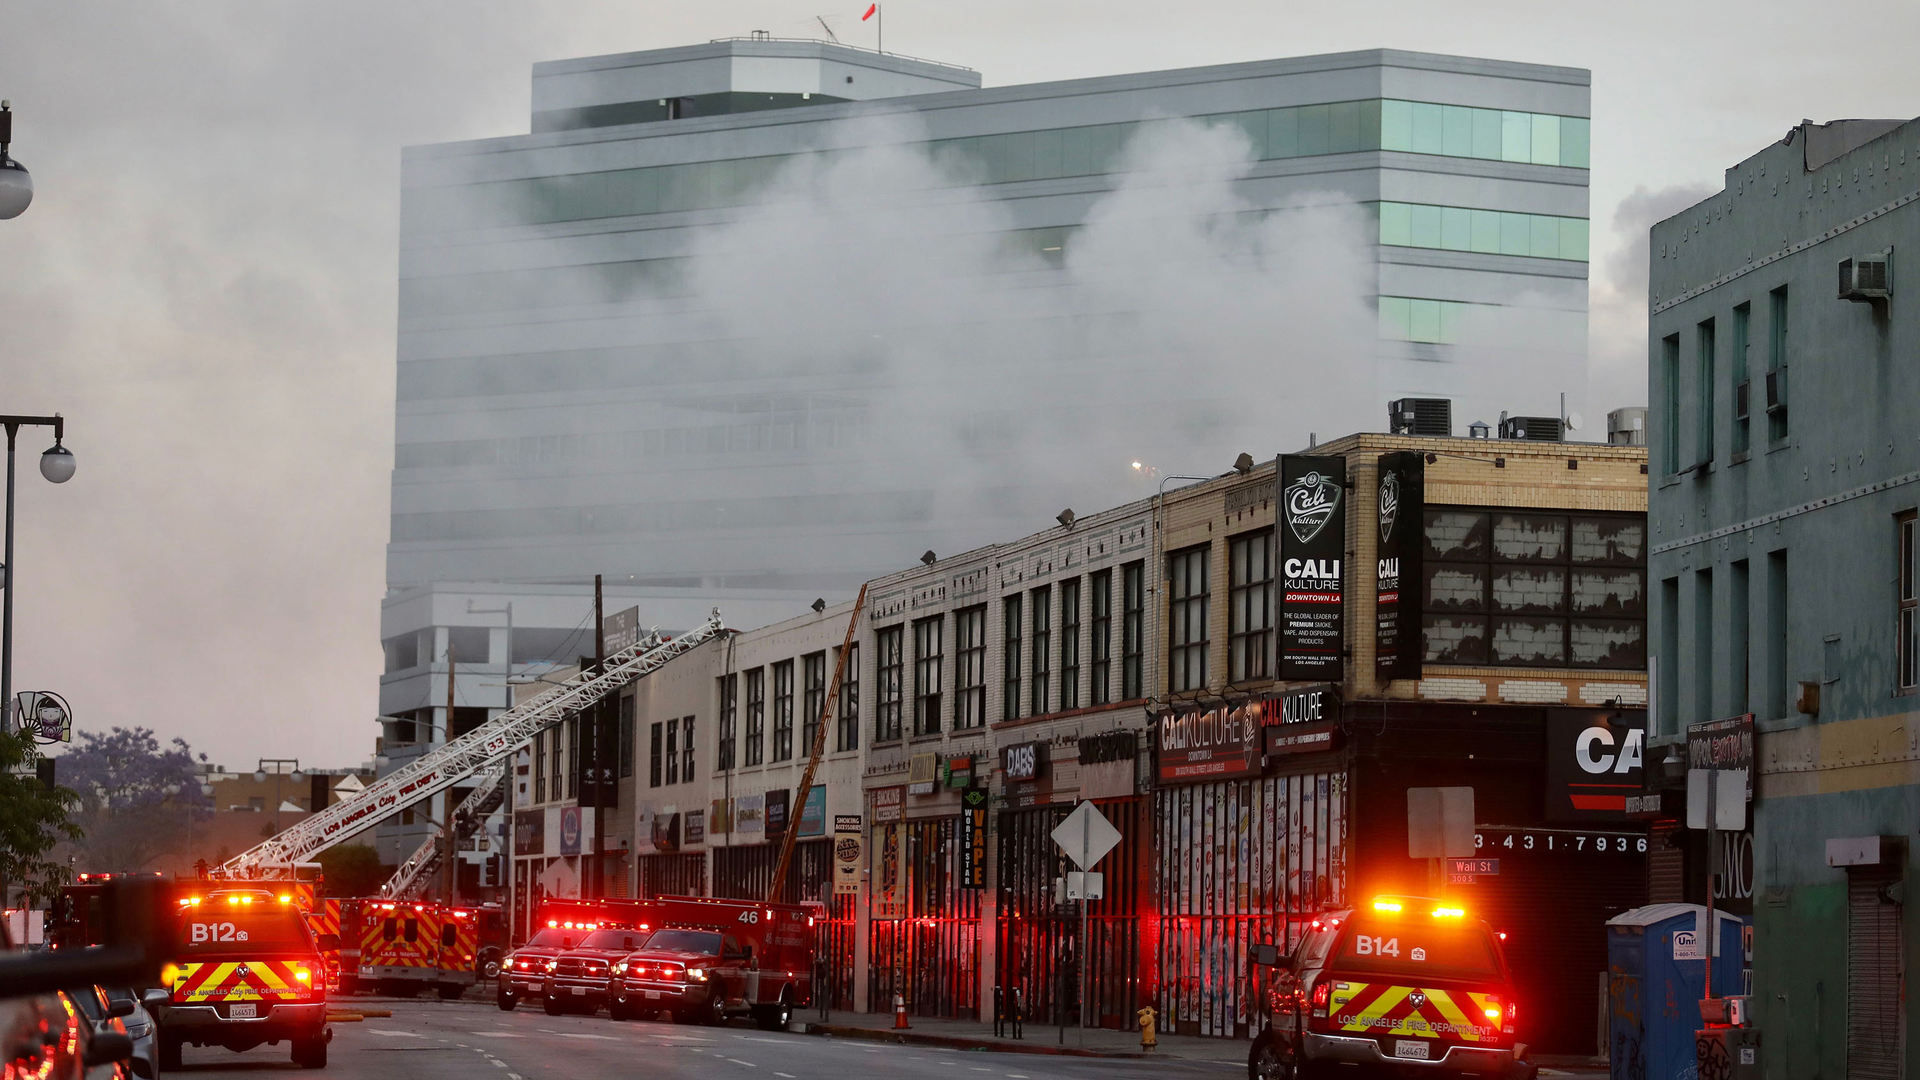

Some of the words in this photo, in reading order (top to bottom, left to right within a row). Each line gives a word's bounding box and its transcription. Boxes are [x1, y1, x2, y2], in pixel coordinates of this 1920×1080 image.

[1290, 484, 1333, 514] Cali
[1284, 558, 1340, 579] CALI
[1378, 557, 1398, 579] CALI
[1284, 579, 1339, 590] KULTURE
[1378, 579, 1398, 590] KULTURE
[487, 737, 504, 752] 33
[1006, 745, 1034, 777] DABS
[1188, 750, 1207, 761] DOWNTOWN
[1208, 750, 1212, 759] LA
[324, 822, 340, 836] LOS
[341, 804, 377, 827] ANGELES
[379, 794, 397, 807] City
[399, 785, 417, 797] FIRE
[417, 772, 439, 788] DEPT.
[877, 788, 900, 805] SMOKING
[876, 805, 901, 821] ACCESSORIES
[973, 809, 984, 885] VAPE
[1456, 862, 1475, 872] Wall
[1480, 861, 1491, 872] St
[367, 916, 377, 926] 11
[738, 911, 758, 924] 46
[192, 922, 235, 942] B12
[1356, 935, 1400, 957] B14
[230, 987, 244, 998] City
[1338, 1014, 1357, 1026] LOS
[1360, 1016, 1403, 1029] ANGELES
[1406, 1020, 1426, 1031] FIRE
[1430, 1022, 1492, 1035] DEPARTMENT
[1397, 1046, 1427, 1056] 1464672
